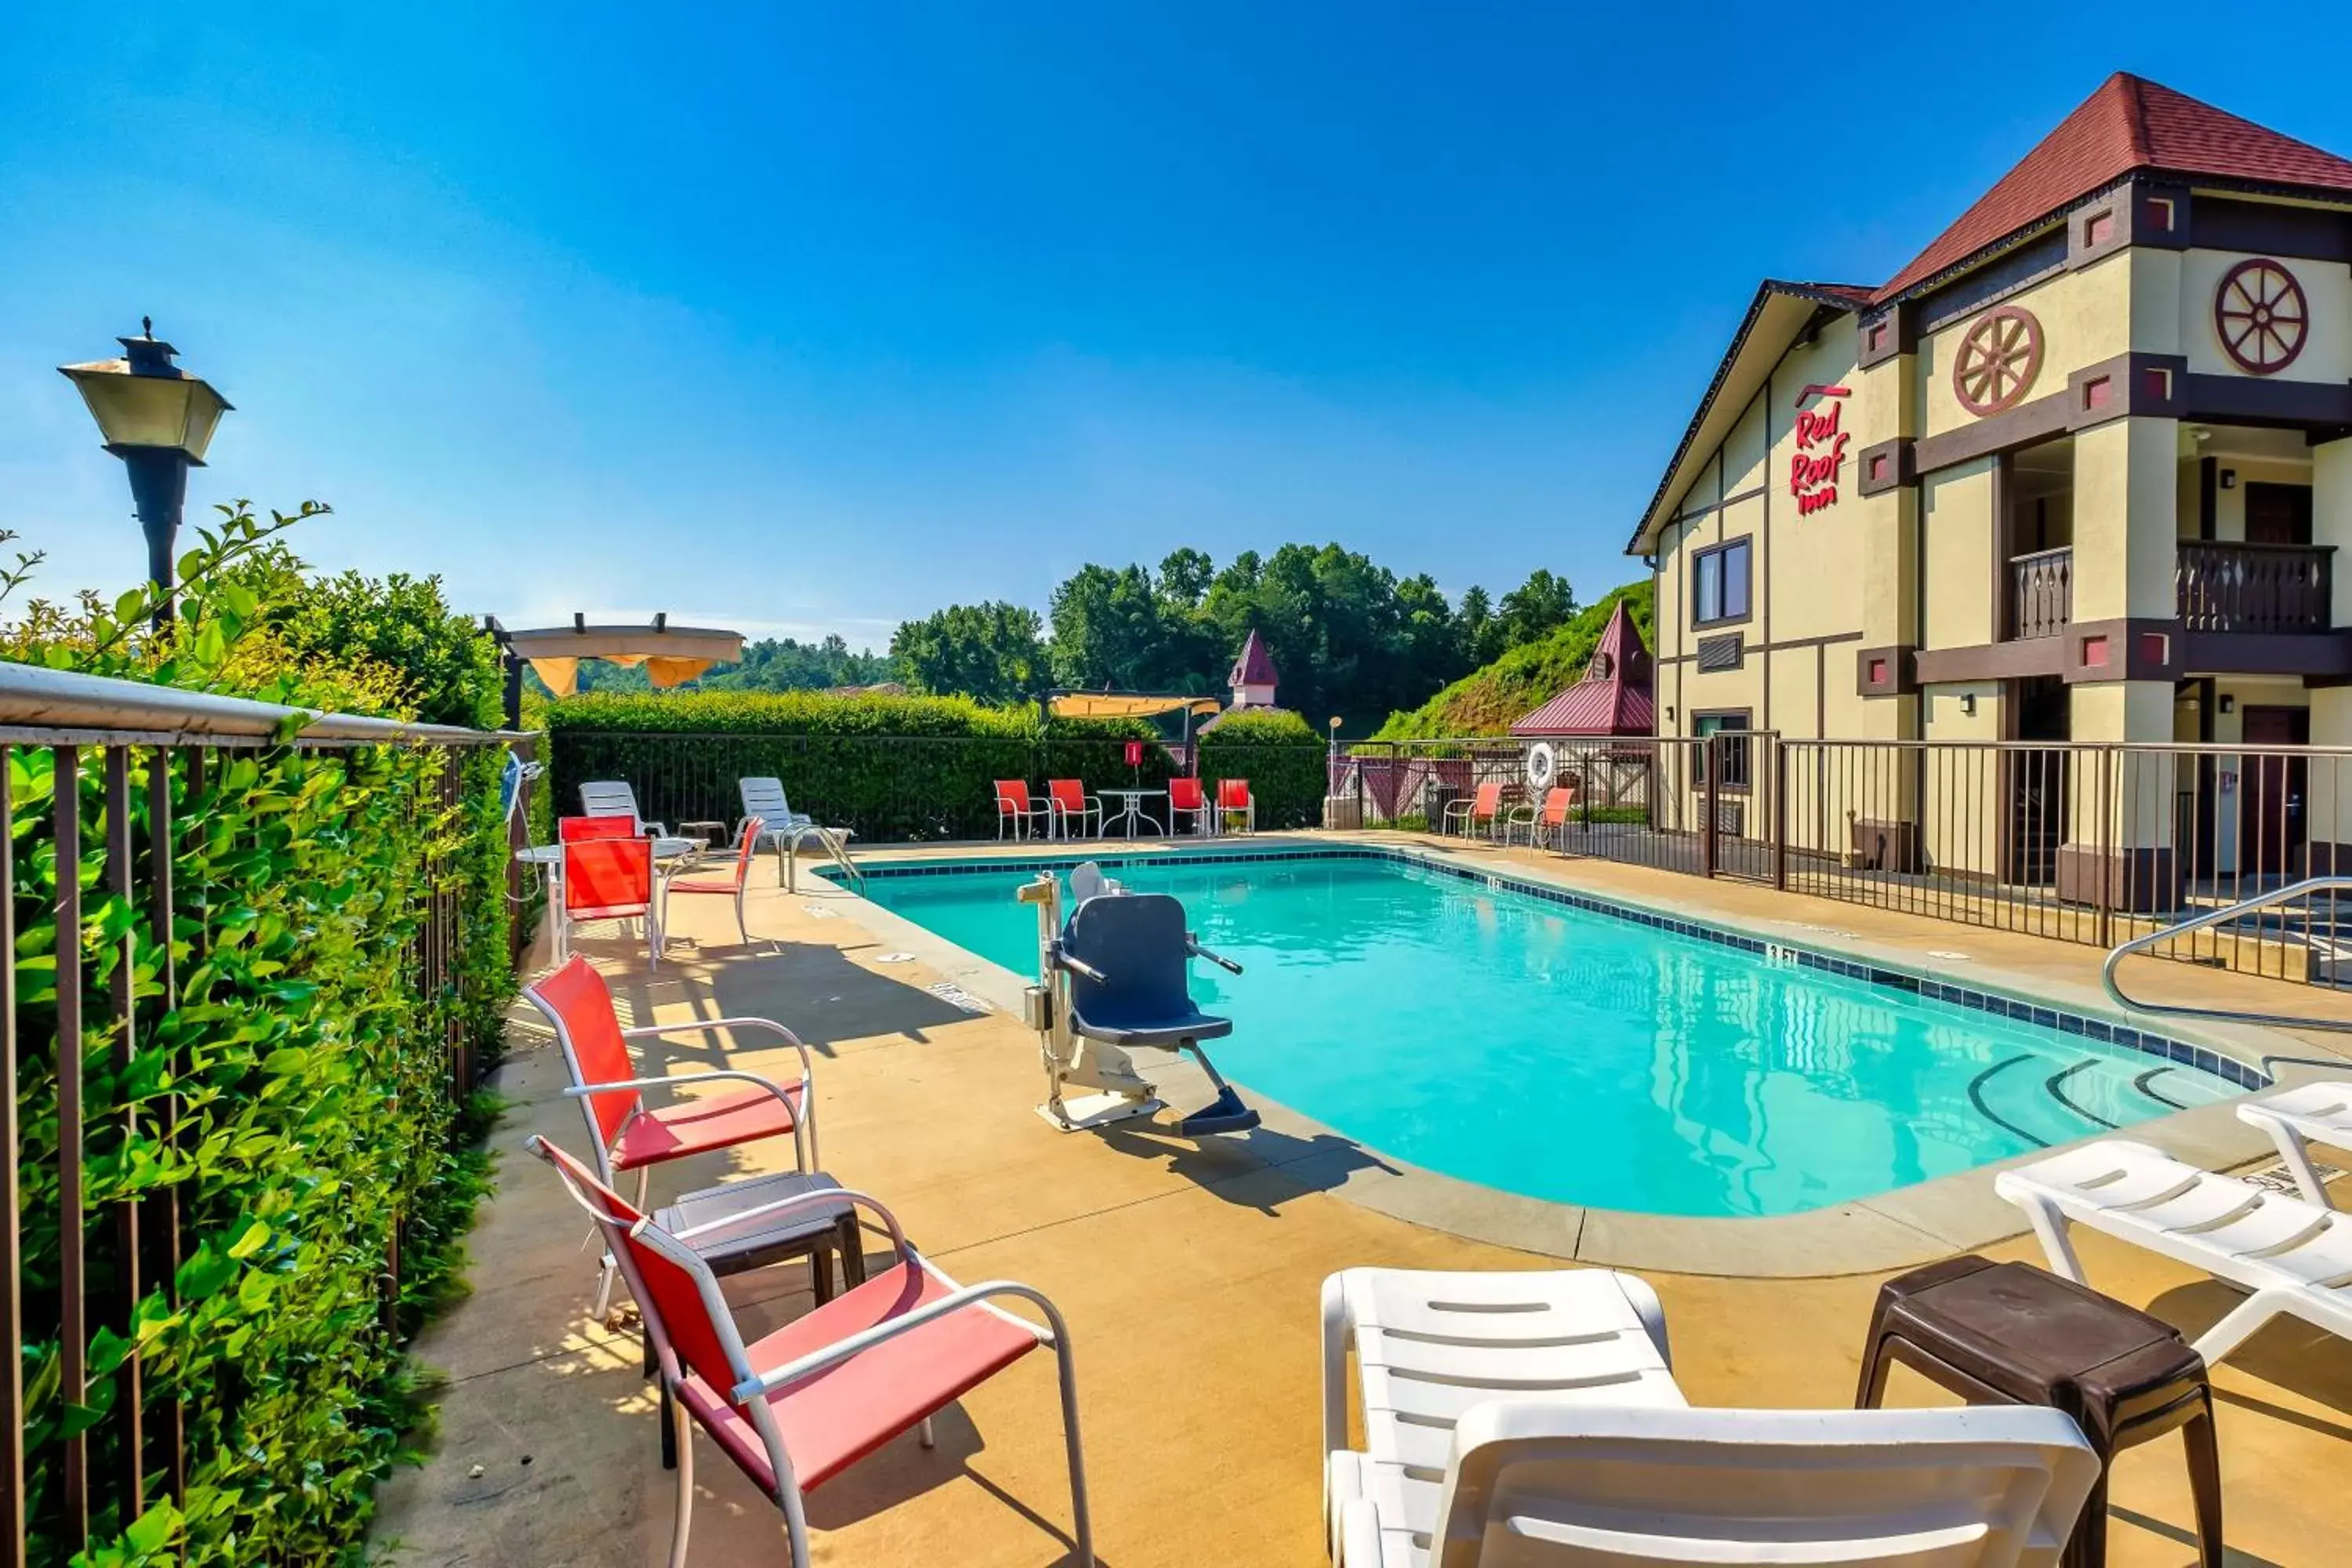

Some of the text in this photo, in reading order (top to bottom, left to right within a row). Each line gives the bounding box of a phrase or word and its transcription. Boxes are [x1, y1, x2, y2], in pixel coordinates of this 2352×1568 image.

[1796, 401, 1841, 449] Red
[1791, 433, 1849, 495] Roof
[1770, 945, 1796, 961] 3 FT
